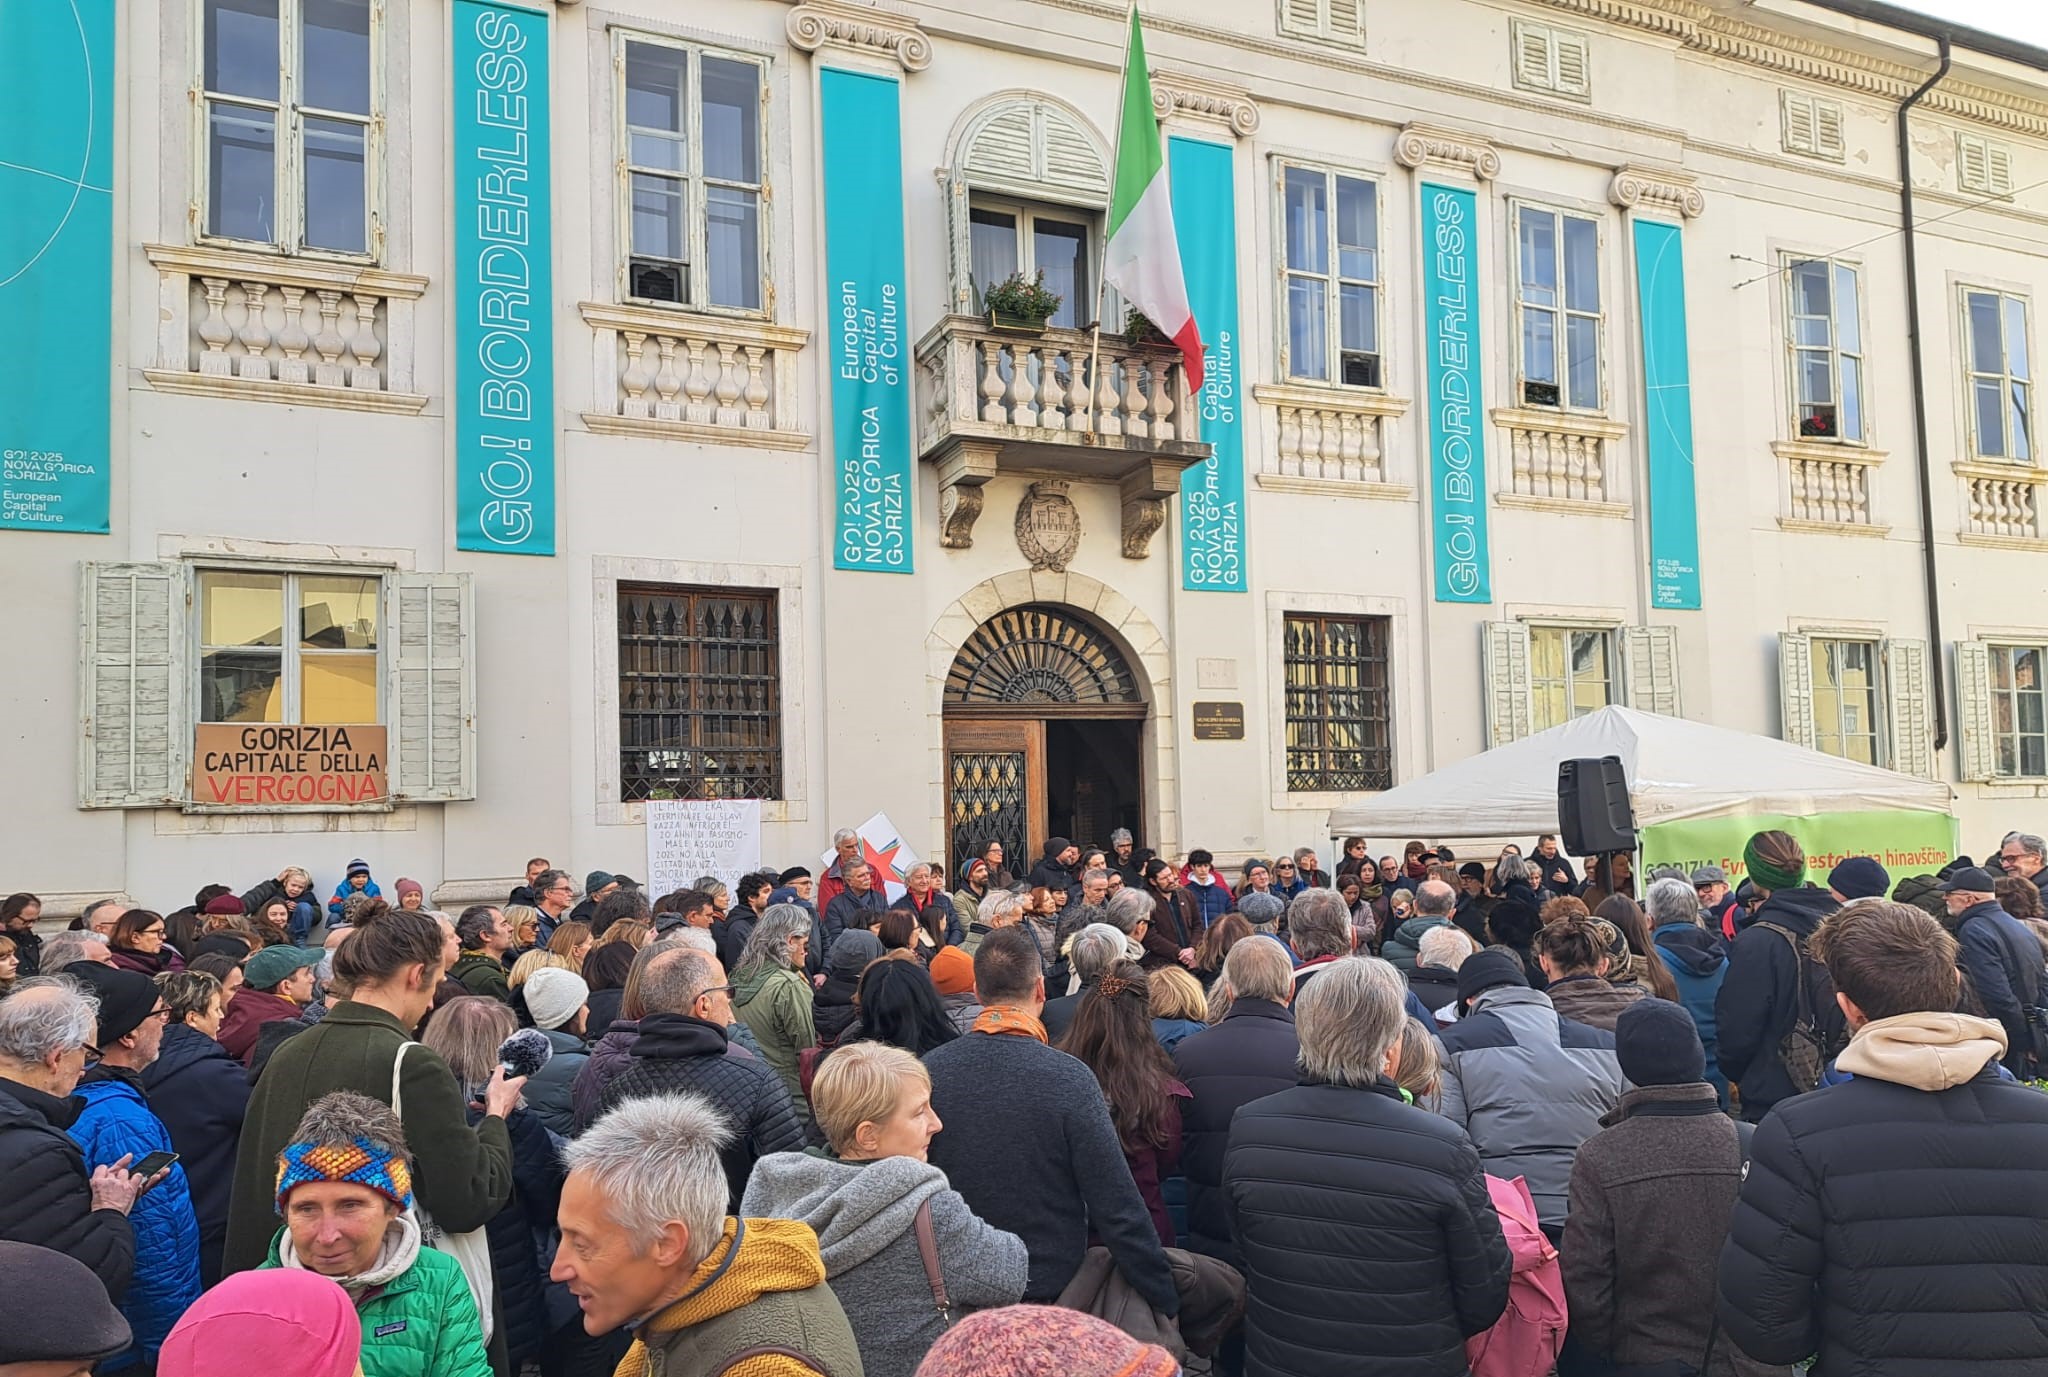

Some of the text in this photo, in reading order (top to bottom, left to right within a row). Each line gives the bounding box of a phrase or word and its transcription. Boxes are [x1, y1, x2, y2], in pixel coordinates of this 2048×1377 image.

[475, 11, 533, 545] GO! BORDERLESS
[842, 280, 861, 380] European
[860, 308, 880, 384] Capital
[880, 283, 898, 386] of Culture
[1203, 354, 1220, 421] Capital
[1218, 330, 1234, 423] of Culture
[1433, 193, 1480, 597] GO! BORDERLESS
[3, 449, 64, 462] GO! 2025
[3, 460, 95, 474] NOVA GORICA
[3, 470, 58, 482] GORIZIA
[862, 406, 882, 563] NOVA GORICA
[2, 511, 64, 522] of Culture
[3, 489, 62, 502] European
[3, 500, 47, 512] Capital
[843, 459, 862, 563] GO! 2025
[884, 473, 904, 566] GORIZIA
[1188, 491, 1206, 584] GO! 2025
[1206, 527, 1222, 584] NOVA
[1223, 501, 1239, 585] GORIZIA
[205, 752, 380, 773] CAPITALE DELLA
[241, 726, 352, 751] GORIZIA
[207, 774, 379, 803] VERGOGNA
[1886, 846, 1948, 867] hinavščine
